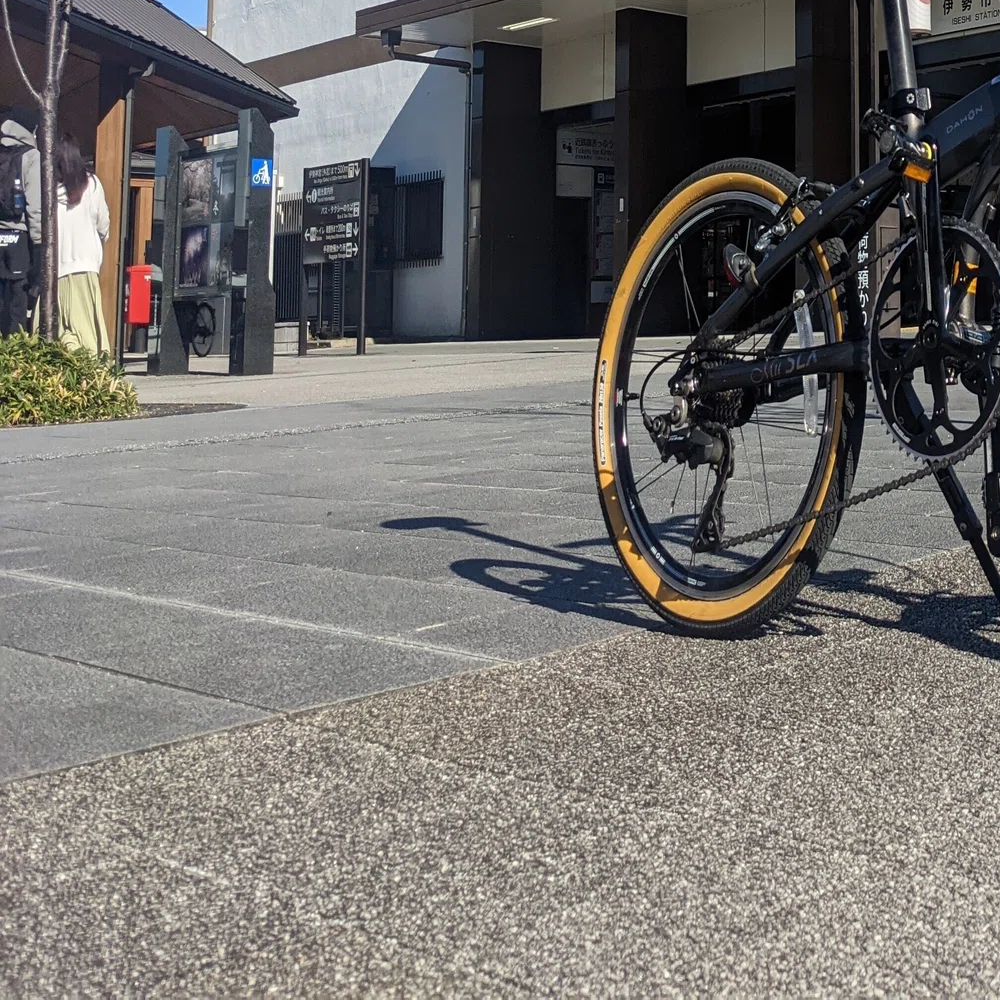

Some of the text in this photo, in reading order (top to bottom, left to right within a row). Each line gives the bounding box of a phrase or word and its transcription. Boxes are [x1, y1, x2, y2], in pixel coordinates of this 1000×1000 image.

[951, 14, 972, 26] ISESHI
[946, 105, 984, 135] DAHON
[0, 234, 19, 244] FORM
